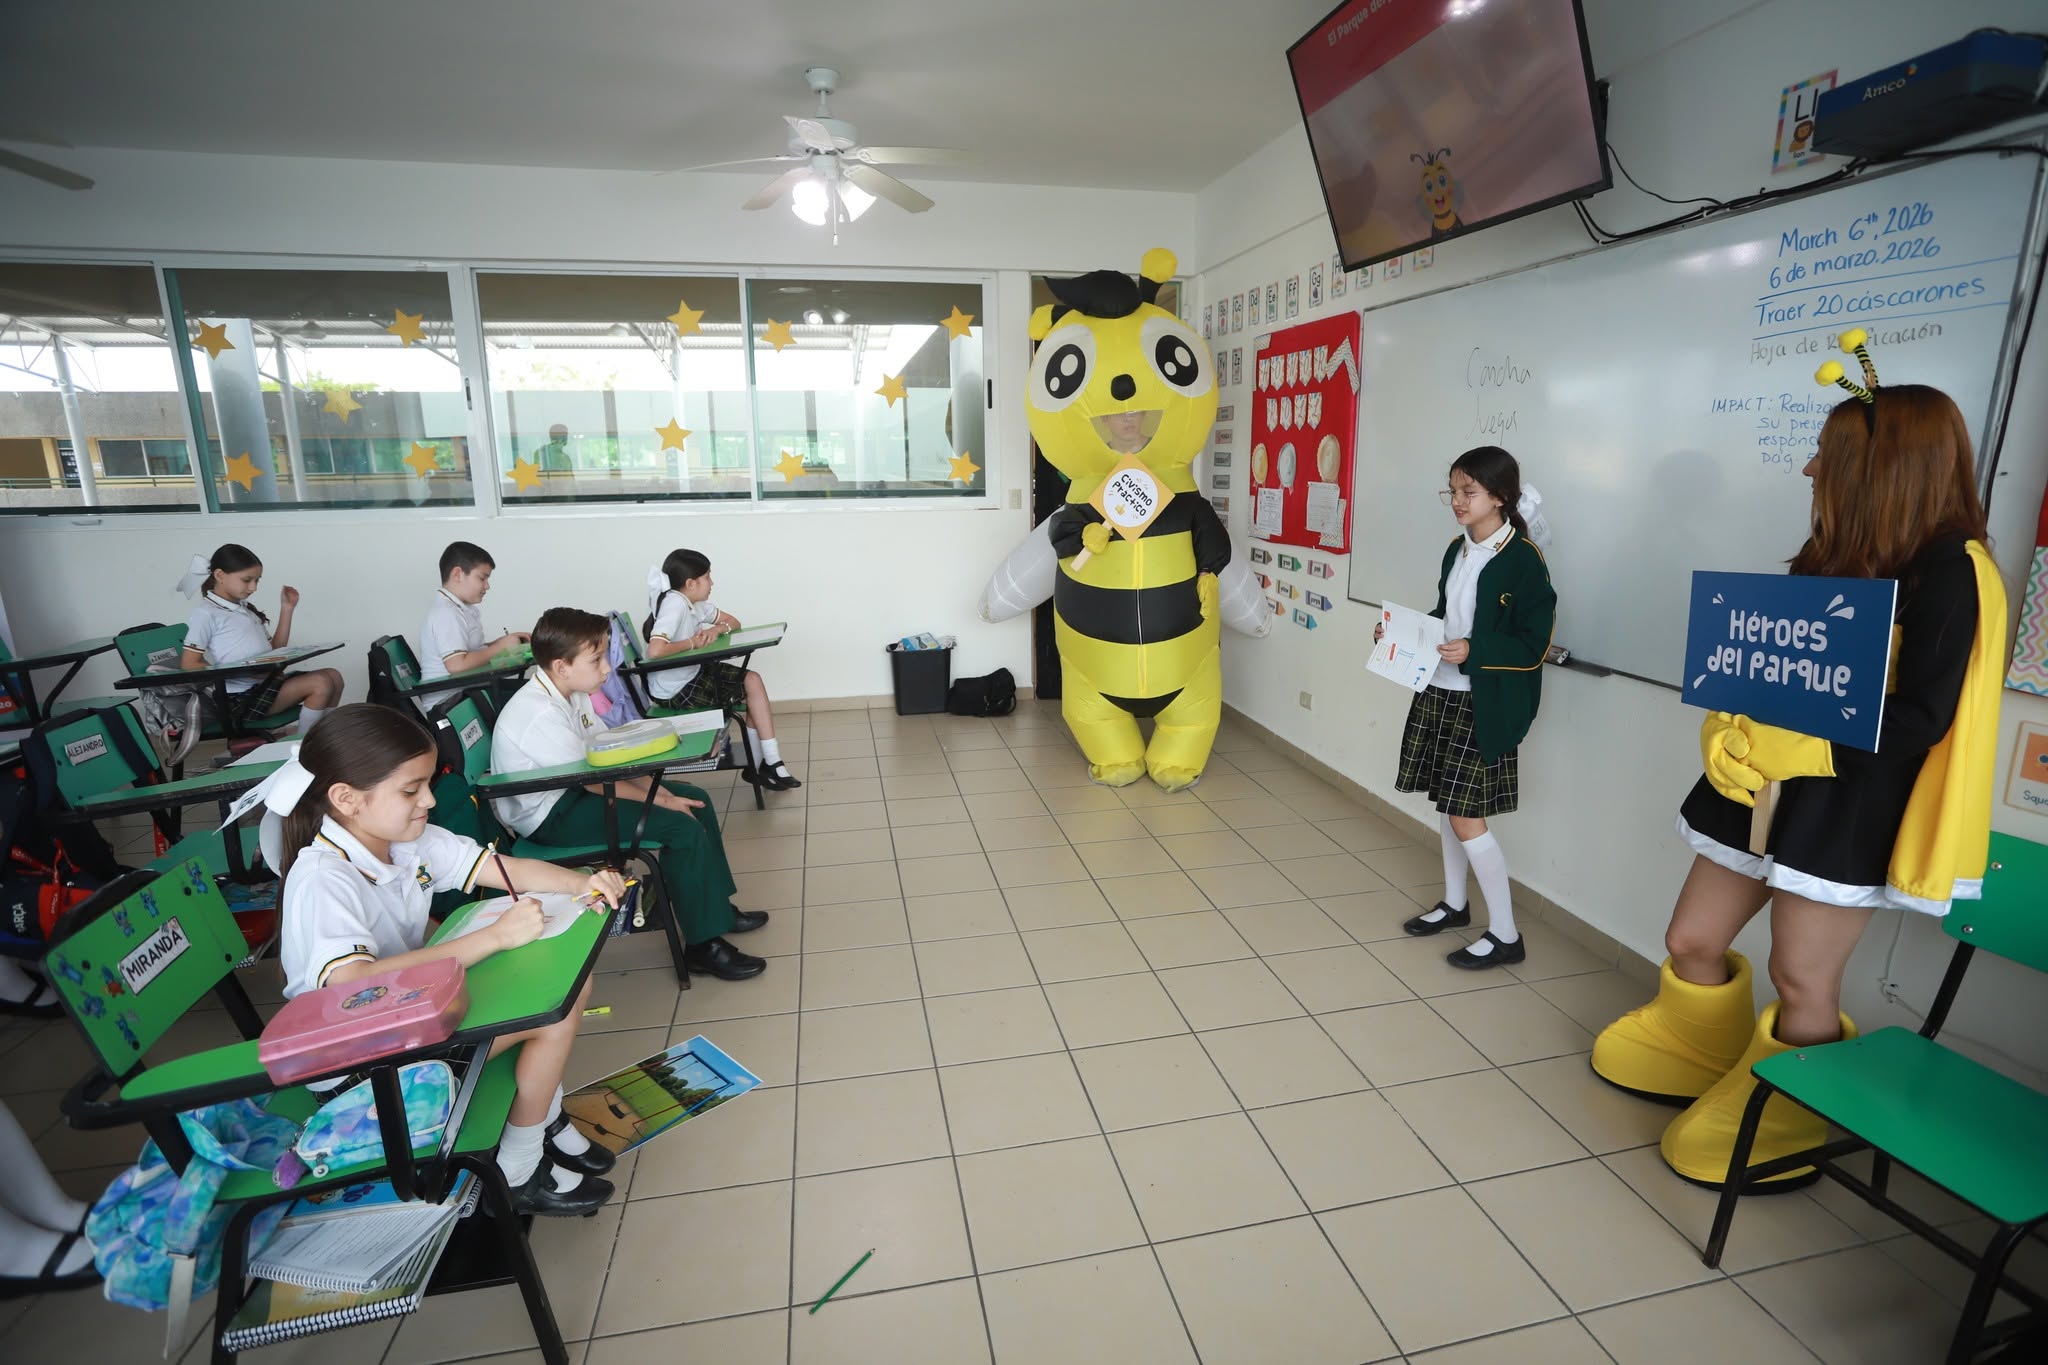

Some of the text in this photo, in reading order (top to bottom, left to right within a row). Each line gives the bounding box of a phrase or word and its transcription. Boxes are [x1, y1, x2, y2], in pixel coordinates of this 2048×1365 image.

[1327, 29, 1337, 47] El
[1337, 7, 1369, 41] Parque
[1862, 77, 1906, 101] Amco
[1778, 227, 1837, 257] March
[1883, 202, 1934, 235] 2026
[1311, 271, 1321, 288] Gg
[1769, 266, 1782, 289] 6
[1786, 262, 1807, 283] de
[1881, 236, 1941, 264] 2026
[1268, 289, 1276, 304] Ee
[1288, 282, 1297, 297] Ff
[1754, 277, 1986, 327] Traer 20 cáscarones
[1751, 342, 1786, 366] Hoja
[1795, 336, 1818, 354] de
[1112, 480, 1147, 517] Practico
[1121, 473, 1153, 507] Civismo
[1729, 609, 1828, 652] Héroes
[1706, 644, 1742, 677] del
[67, 738, 104, 758] ALEJANDRO
[125, 930, 183, 982] MIRANDA
